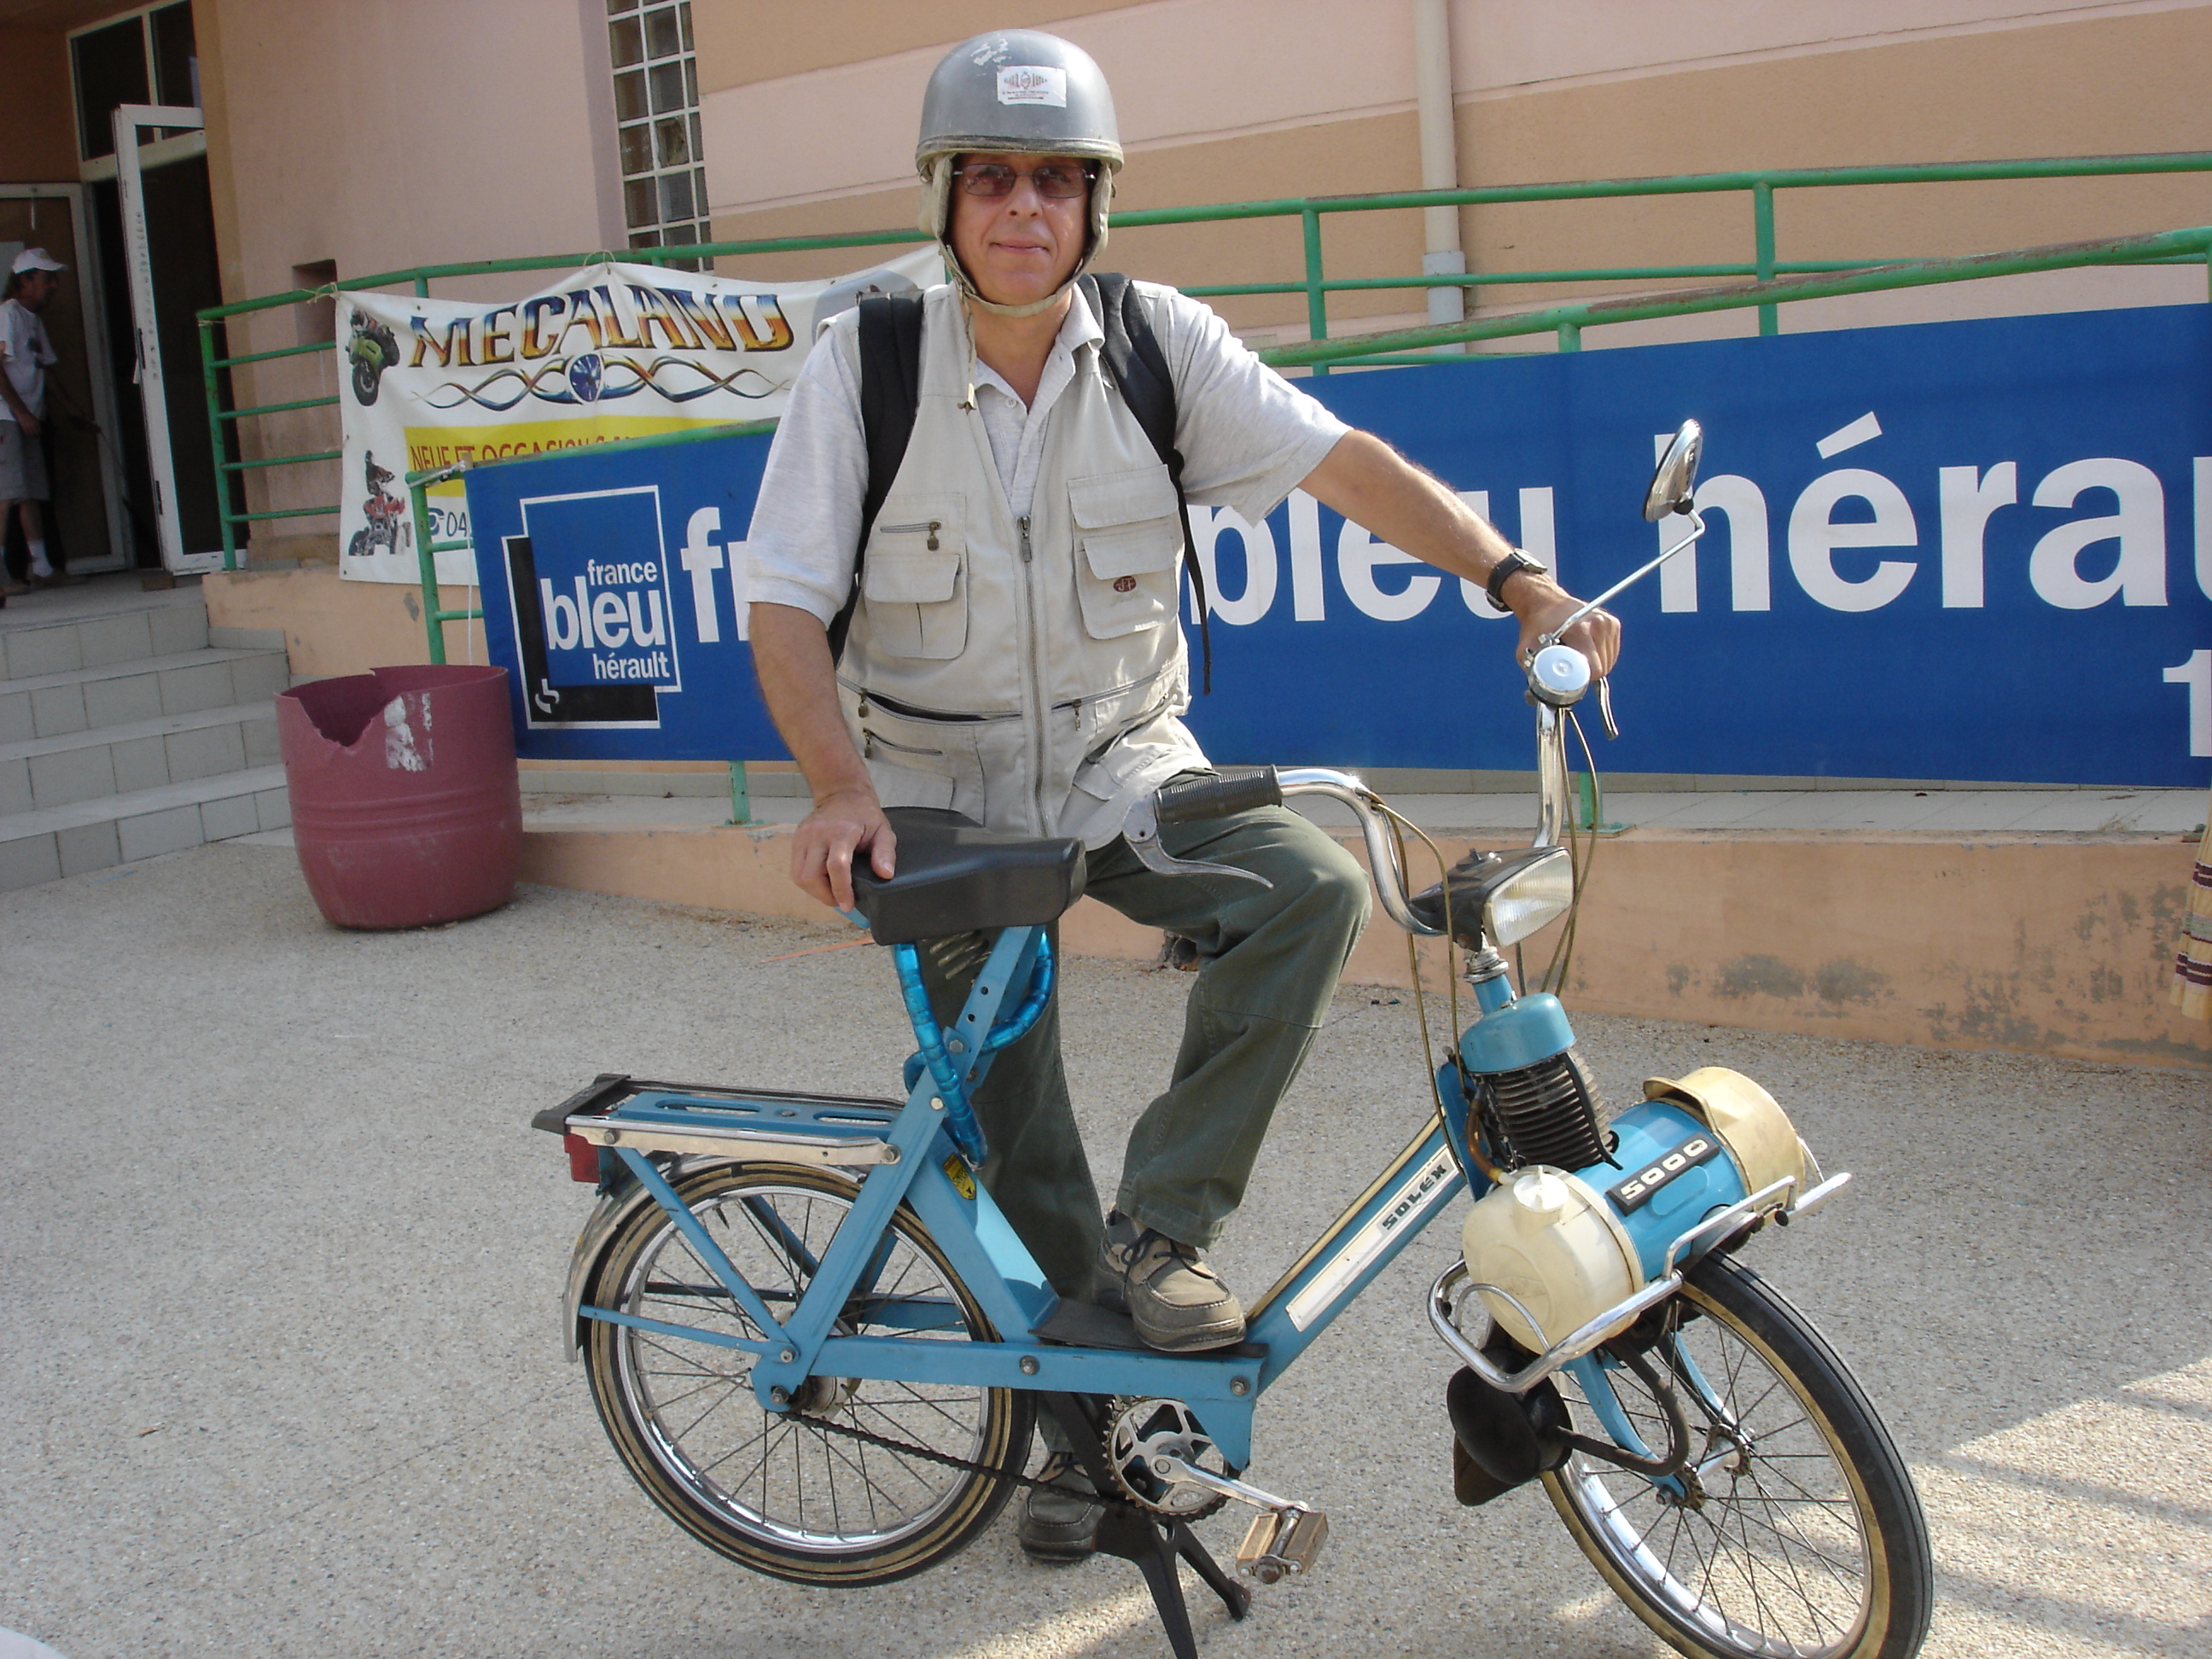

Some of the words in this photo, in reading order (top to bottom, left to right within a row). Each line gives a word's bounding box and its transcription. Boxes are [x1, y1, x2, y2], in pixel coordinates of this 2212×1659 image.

[409, 283, 795, 368] MECALAND
[1654, 411, 2212, 612] héra
[587, 559, 658, 586] france
[540, 575, 667, 650] bleu
[592, 651, 670, 680] hérault
[1382, 1164, 1447, 1230] SOLEX
[1621, 1139, 1708, 1200] 5000
